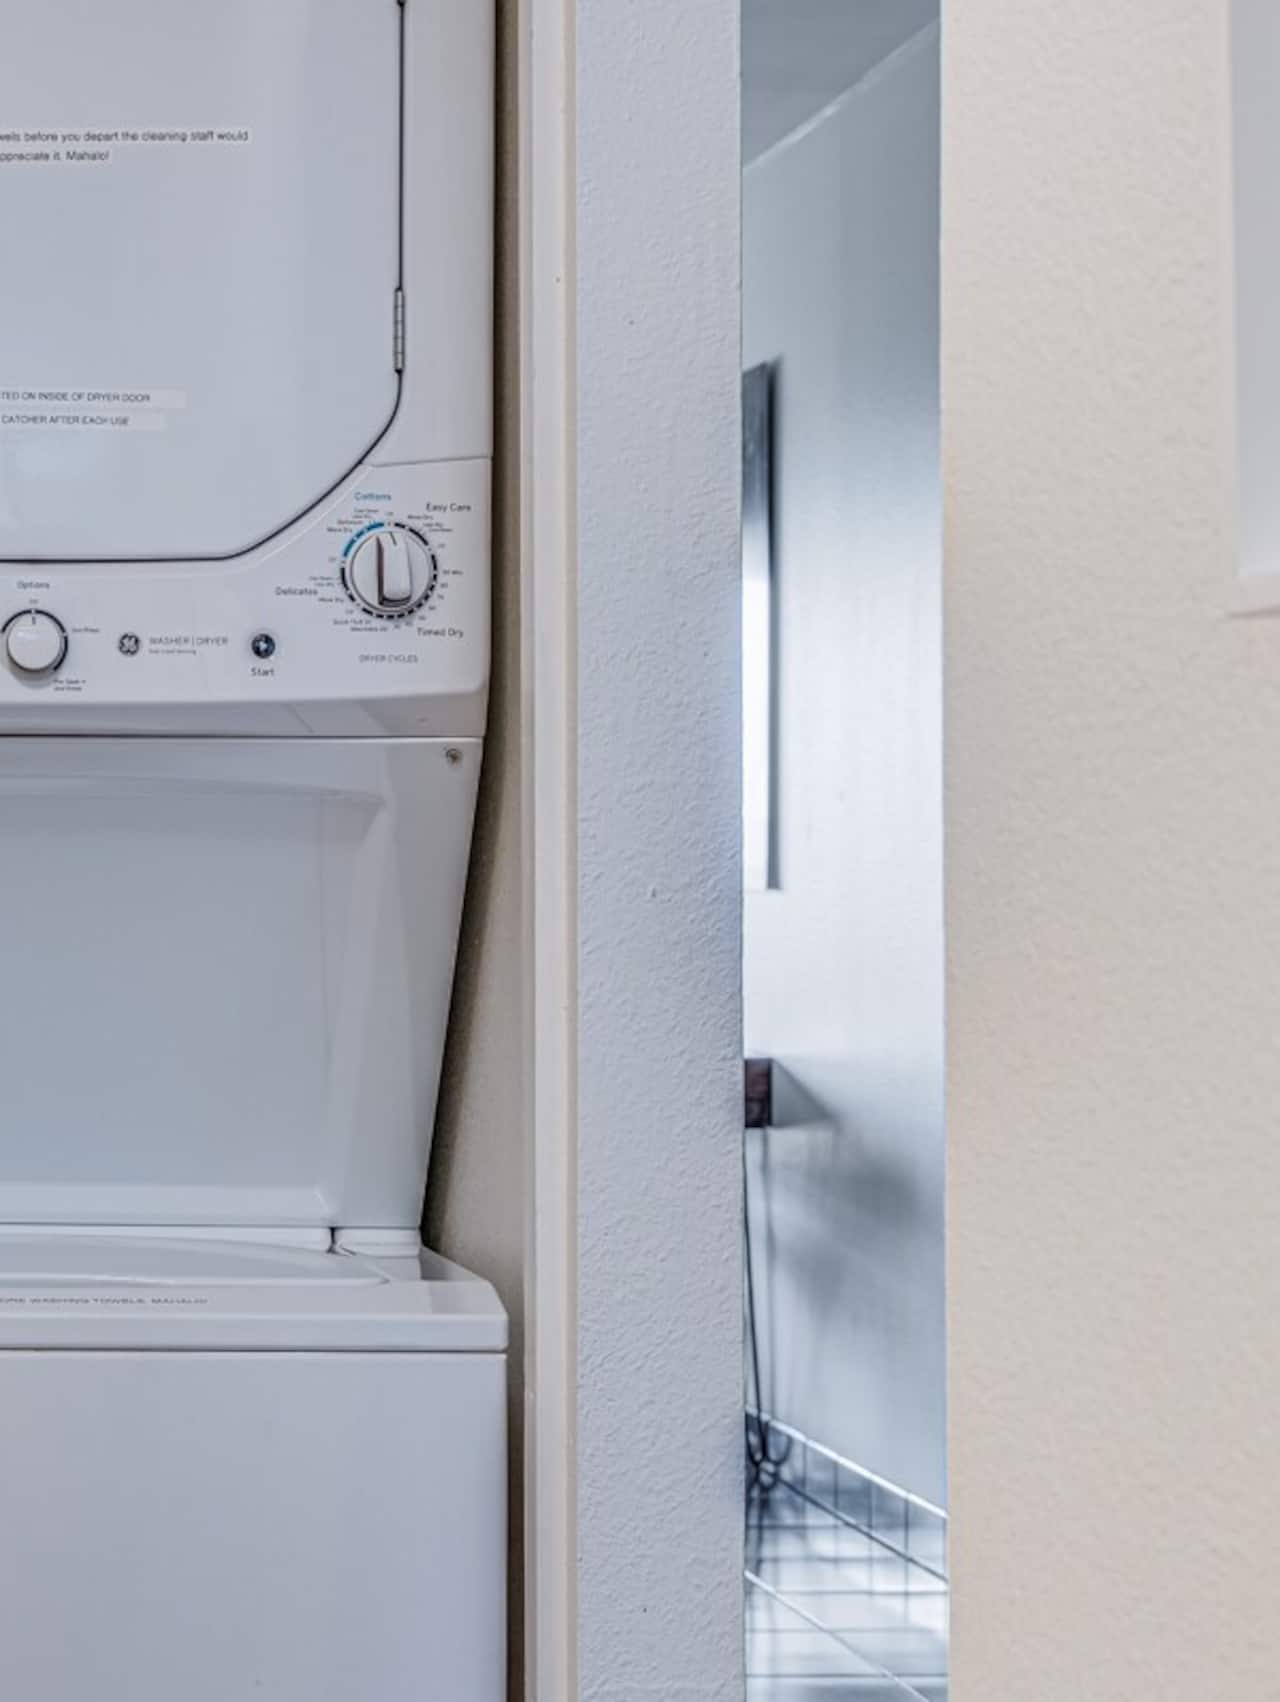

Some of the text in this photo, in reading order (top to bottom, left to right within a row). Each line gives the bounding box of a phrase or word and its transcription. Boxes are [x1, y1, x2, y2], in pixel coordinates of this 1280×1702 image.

[24, 132, 58, 142] before
[61, 133, 81, 144] you
[83, 132, 119, 143] depart
[121, 131, 138, 142] the
[141, 131, 187, 143] cleaning
[190, 131, 214, 142] staff
[217, 131, 249, 142] would
[21, 391, 36, 401] ON
[38, 391, 69, 401] INSIDE
[71, 391, 85, 401] OF
[87, 392, 120, 402] DRYER
[1, 415, 48, 425] CATCHER
[49, 415, 80, 425] AFTER
[426, 503, 471, 514] Easy Care
[417, 627, 464, 639] Timed Dry
[251, 667, 275, 677] Start
